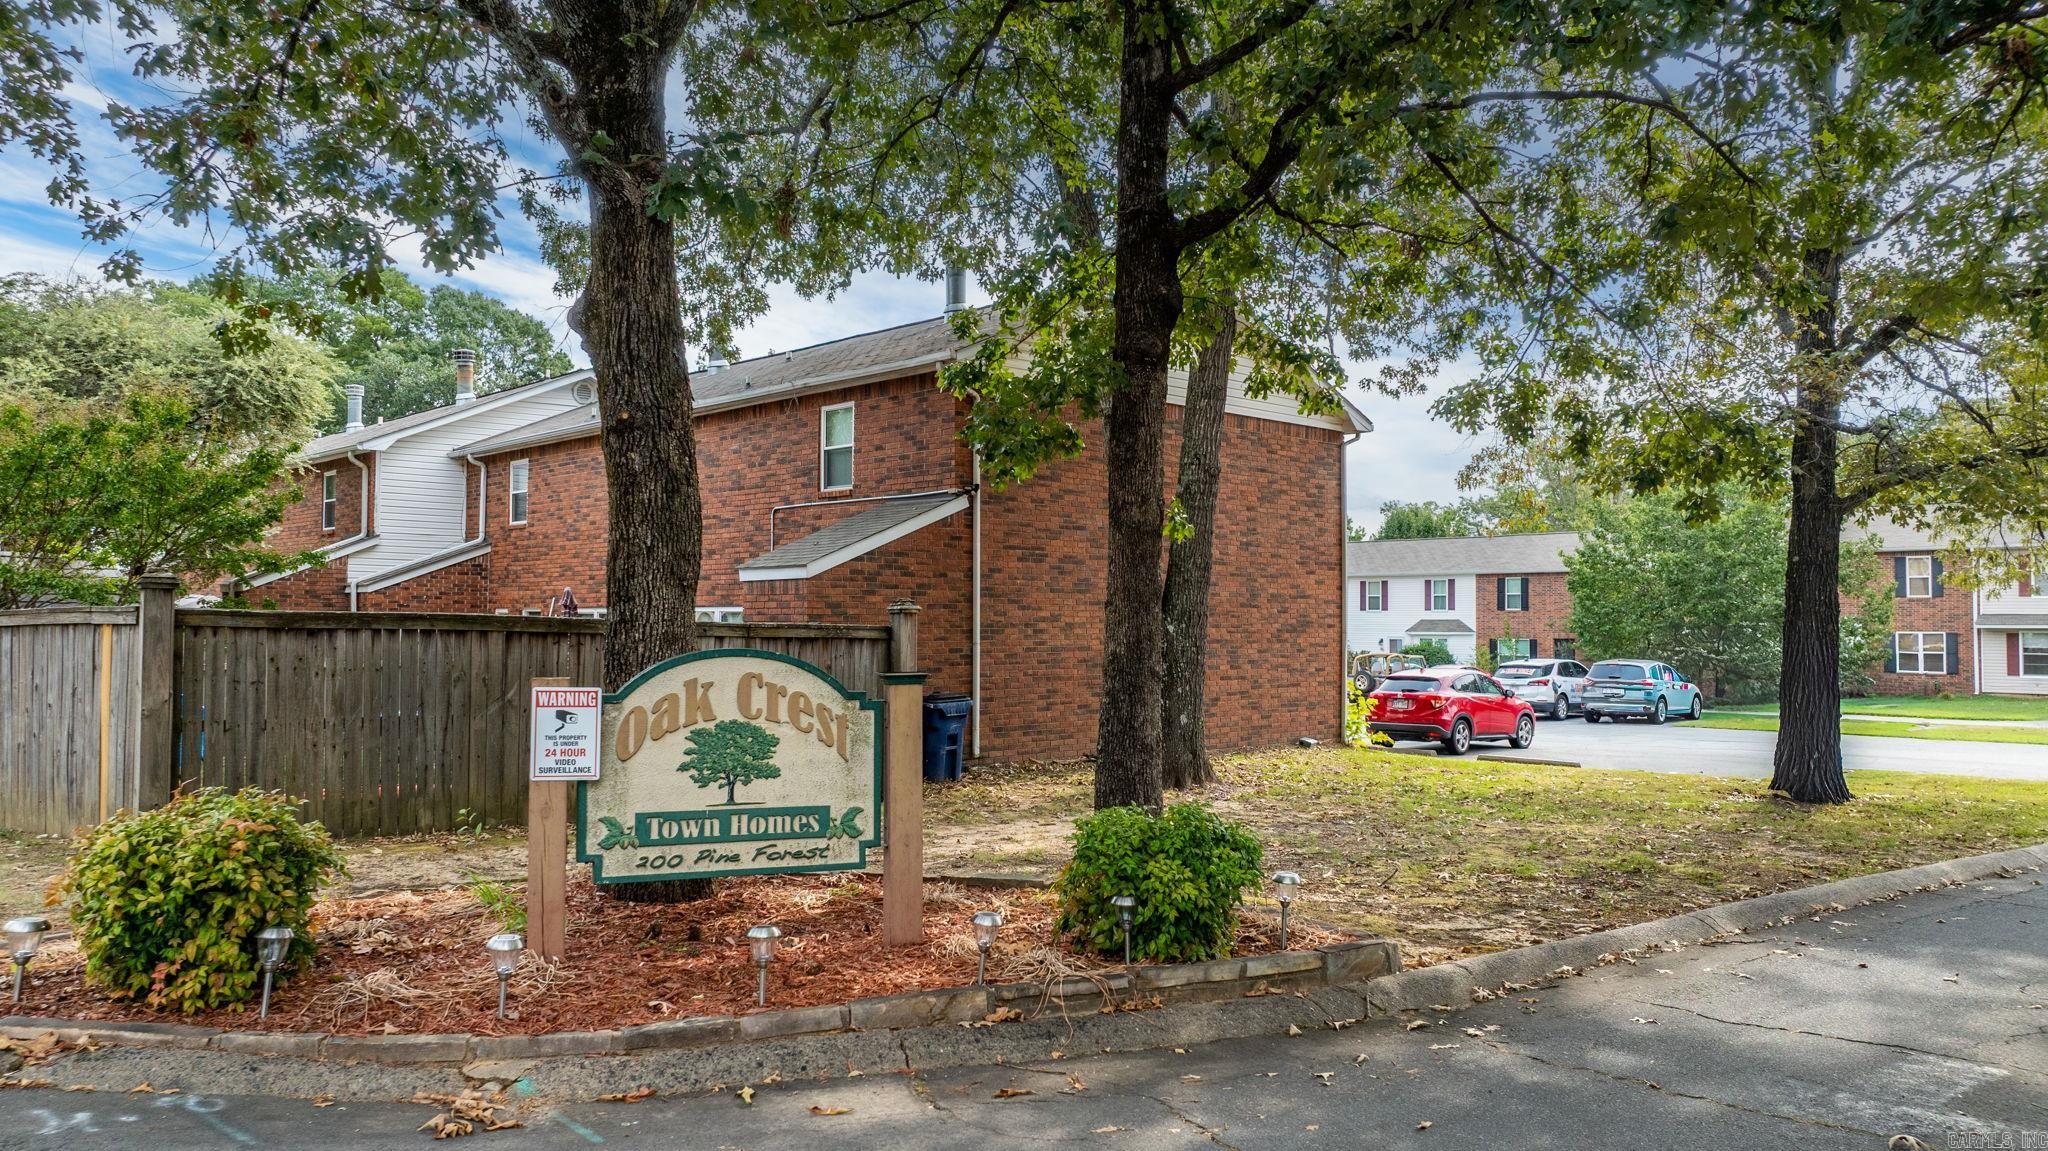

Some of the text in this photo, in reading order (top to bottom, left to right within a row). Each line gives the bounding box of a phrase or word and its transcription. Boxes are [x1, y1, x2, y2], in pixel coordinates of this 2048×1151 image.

[538, 691, 597, 706] WARNING
[616, 671, 849, 762] Oak Crest
[545, 748, 586, 757] 24 HOUR
[538, 766, 592, 774] SURVEILLANCE
[646, 813, 820, 840] Town Homes
[635, 844, 830, 869] 200 Pine Forest
